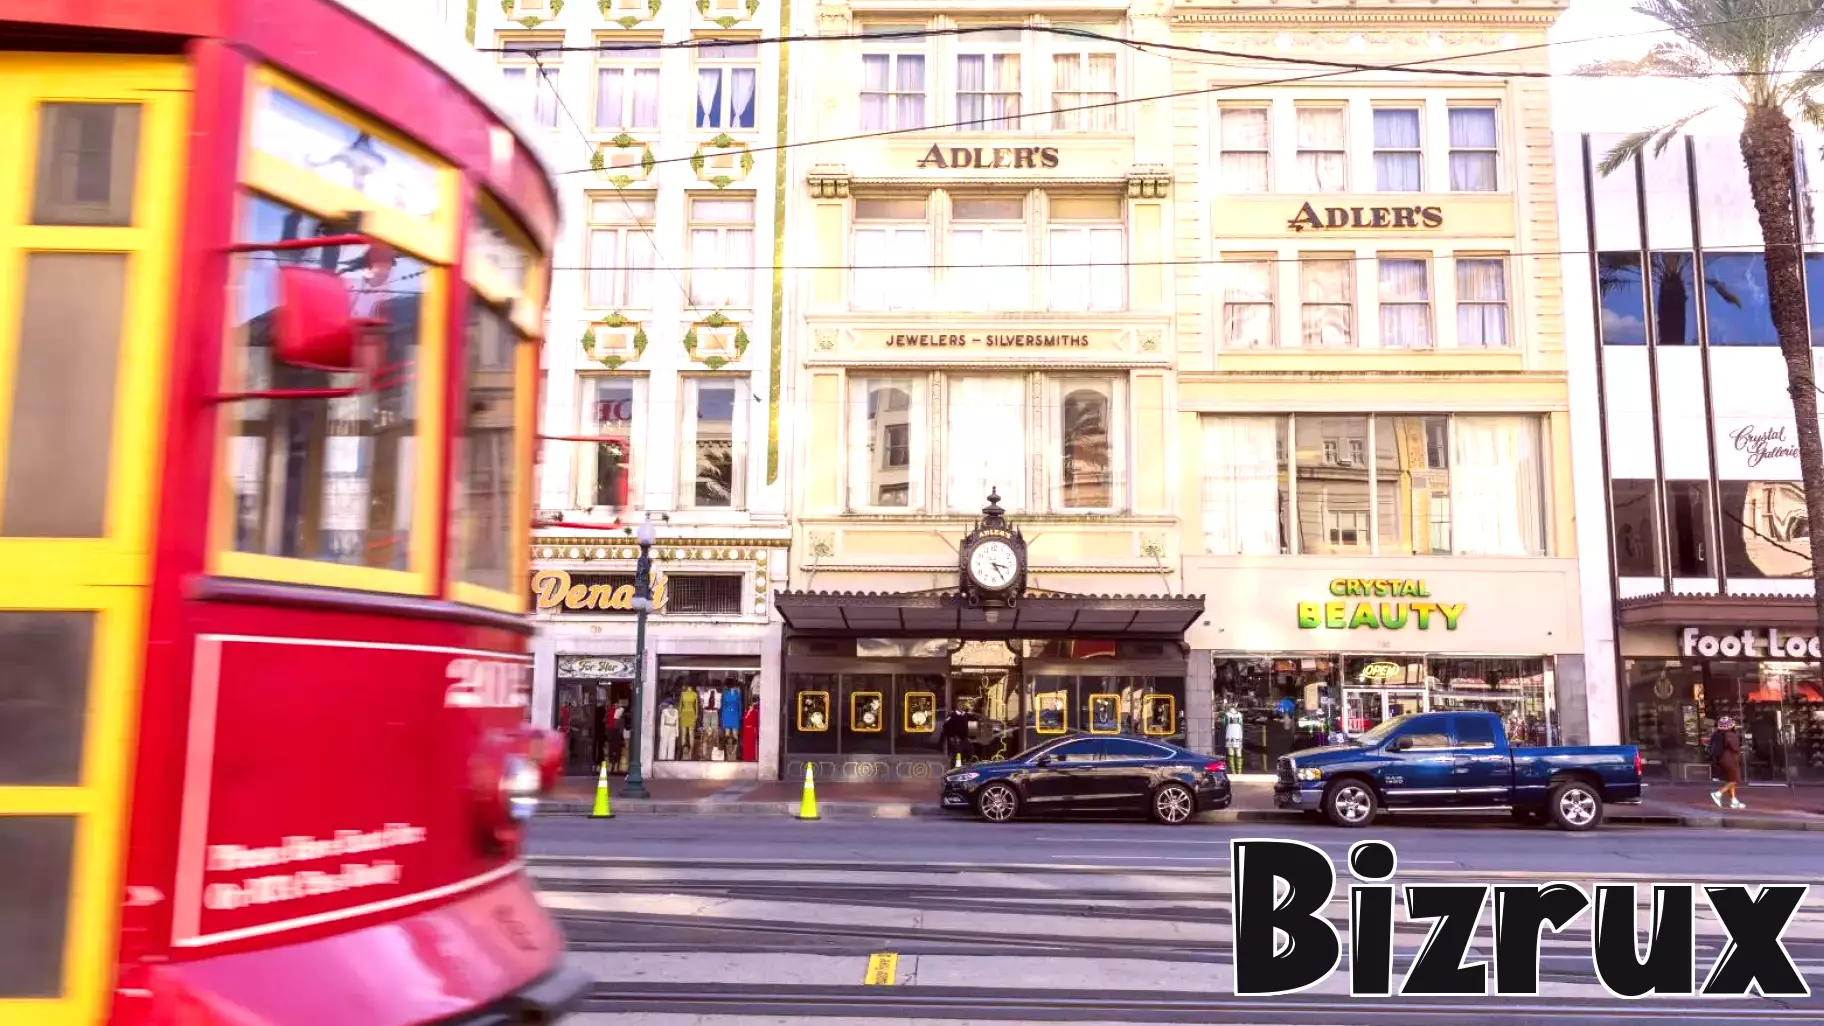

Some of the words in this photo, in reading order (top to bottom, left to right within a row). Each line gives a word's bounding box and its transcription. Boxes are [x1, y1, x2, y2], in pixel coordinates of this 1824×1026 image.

[917, 142, 1059, 169] ADLER'S
[1287, 201, 1443, 230] ADLER'S
[886, 334, 966, 347] JEWELERS
[986, 334, 1089, 347] SILVERSMITHS
[1729, 424, 1787, 450] Crystal
[1747, 441, 1800, 468] Gallerie
[531, 569, 669, 610] Denai
[1330, 578, 1431, 597] CRYSTAL
[1298, 602, 1466, 630] BEAUTY
[1683, 627, 1756, 657] Foot
[1365, 664, 1397, 678] OPEN
